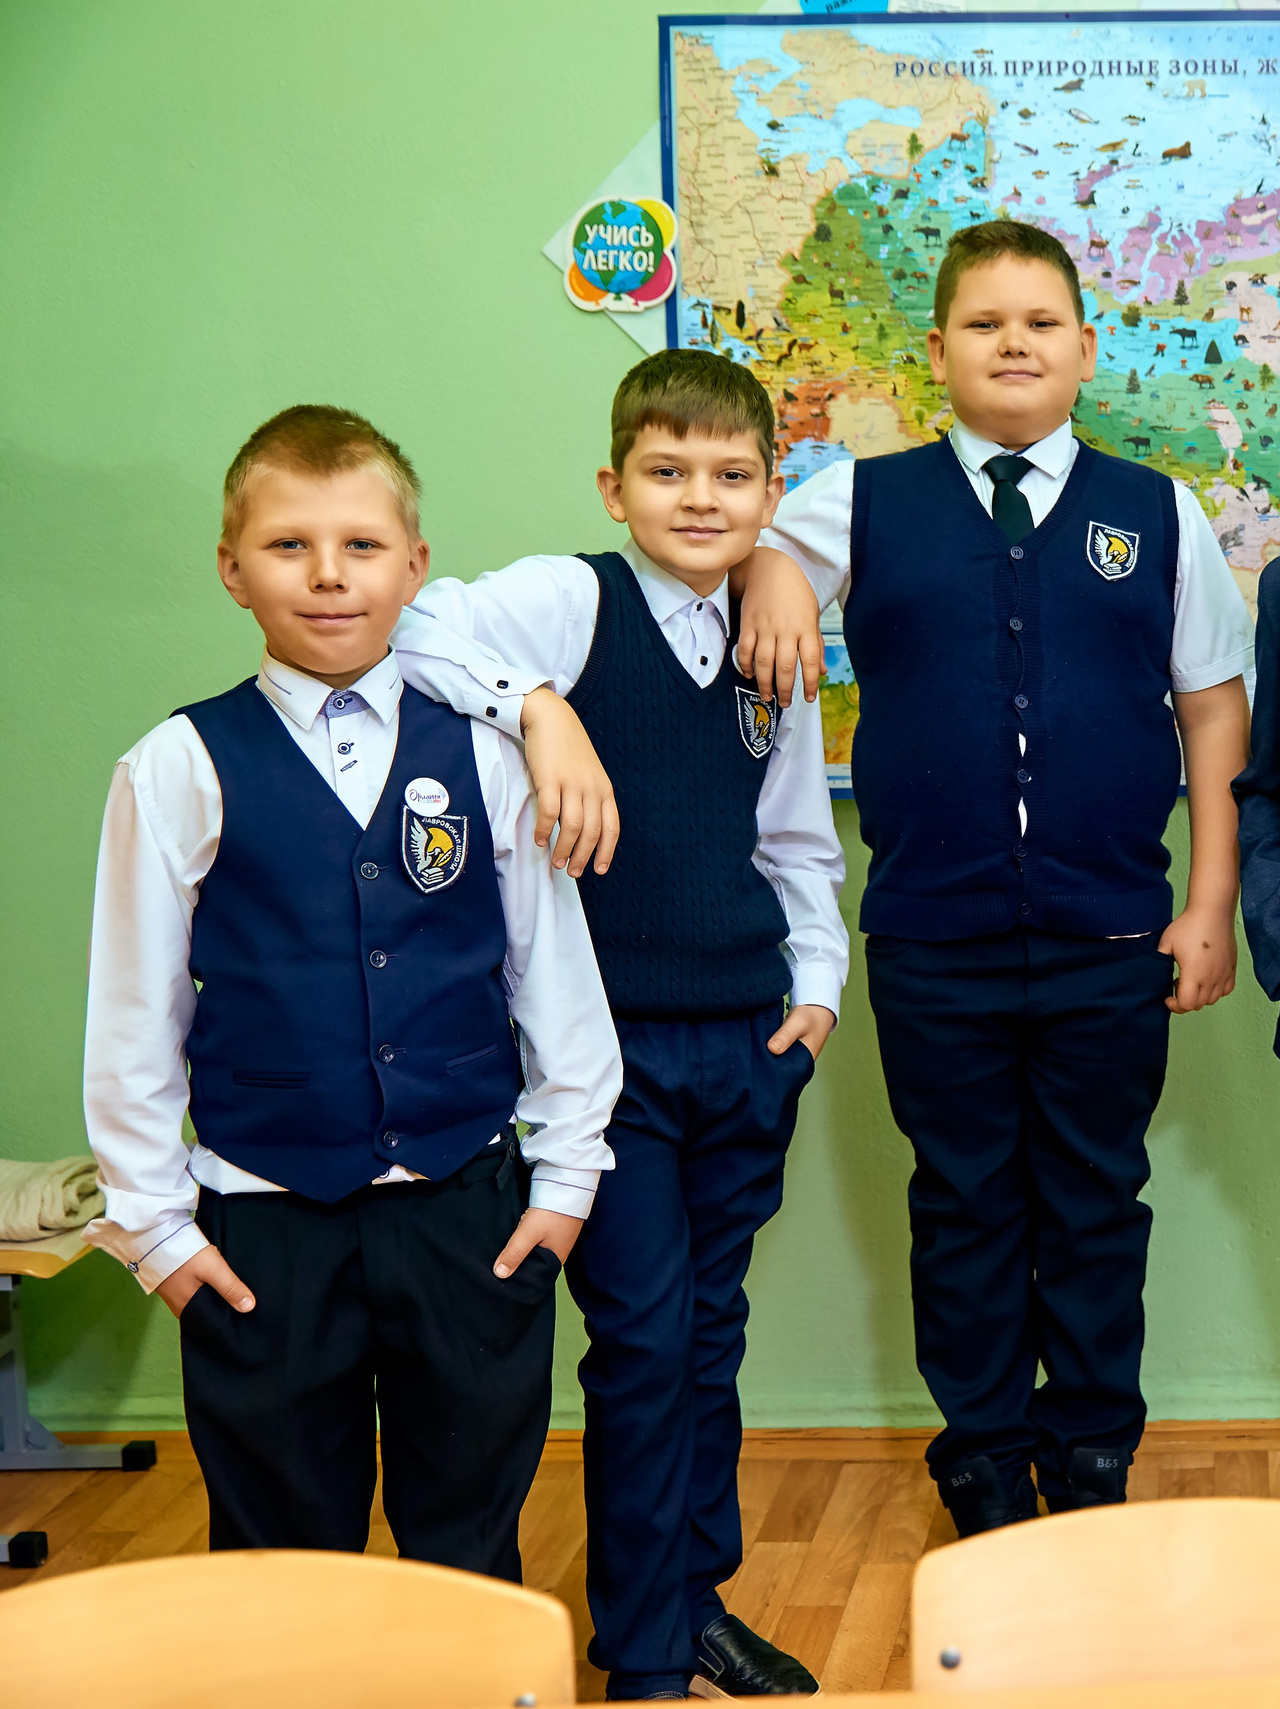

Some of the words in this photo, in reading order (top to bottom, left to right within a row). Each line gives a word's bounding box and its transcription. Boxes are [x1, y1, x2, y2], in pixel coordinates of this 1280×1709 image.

[894, 60, 997, 78] РОССИЯ.
[1003, 59, 1160, 80] ПРИРОДНЫЕ
[1168, 58, 1247, 77] ЗОНЫ,
[584, 223, 655, 248] УЧИСЬ
[582, 249, 655, 273] ЛЕГКО!
[422, 817, 462, 844] ЛАВРОВСКАЯ
[449, 845, 463, 871] ШКОЛА
